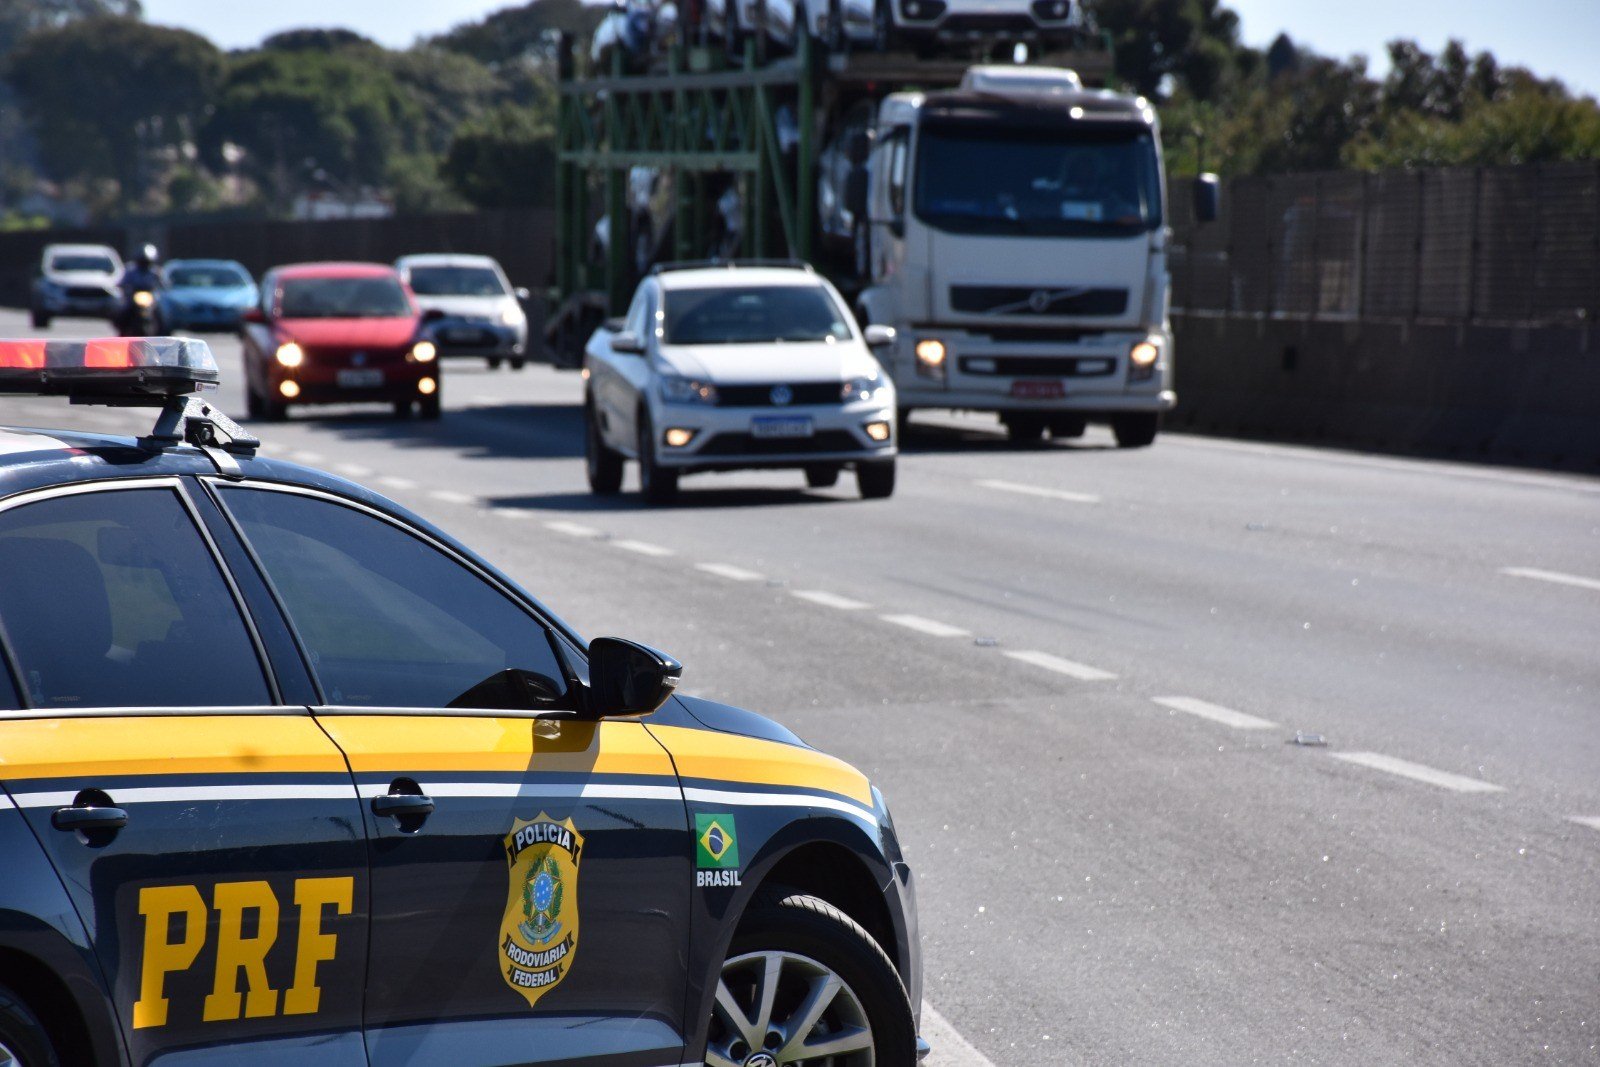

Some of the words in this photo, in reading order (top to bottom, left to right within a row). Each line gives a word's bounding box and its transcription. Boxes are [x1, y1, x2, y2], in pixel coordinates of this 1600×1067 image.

[696, 870, 742, 887] BRASIL
[133, 877, 353, 1029] PRF
[513, 969, 556, 987] FEDERAL
